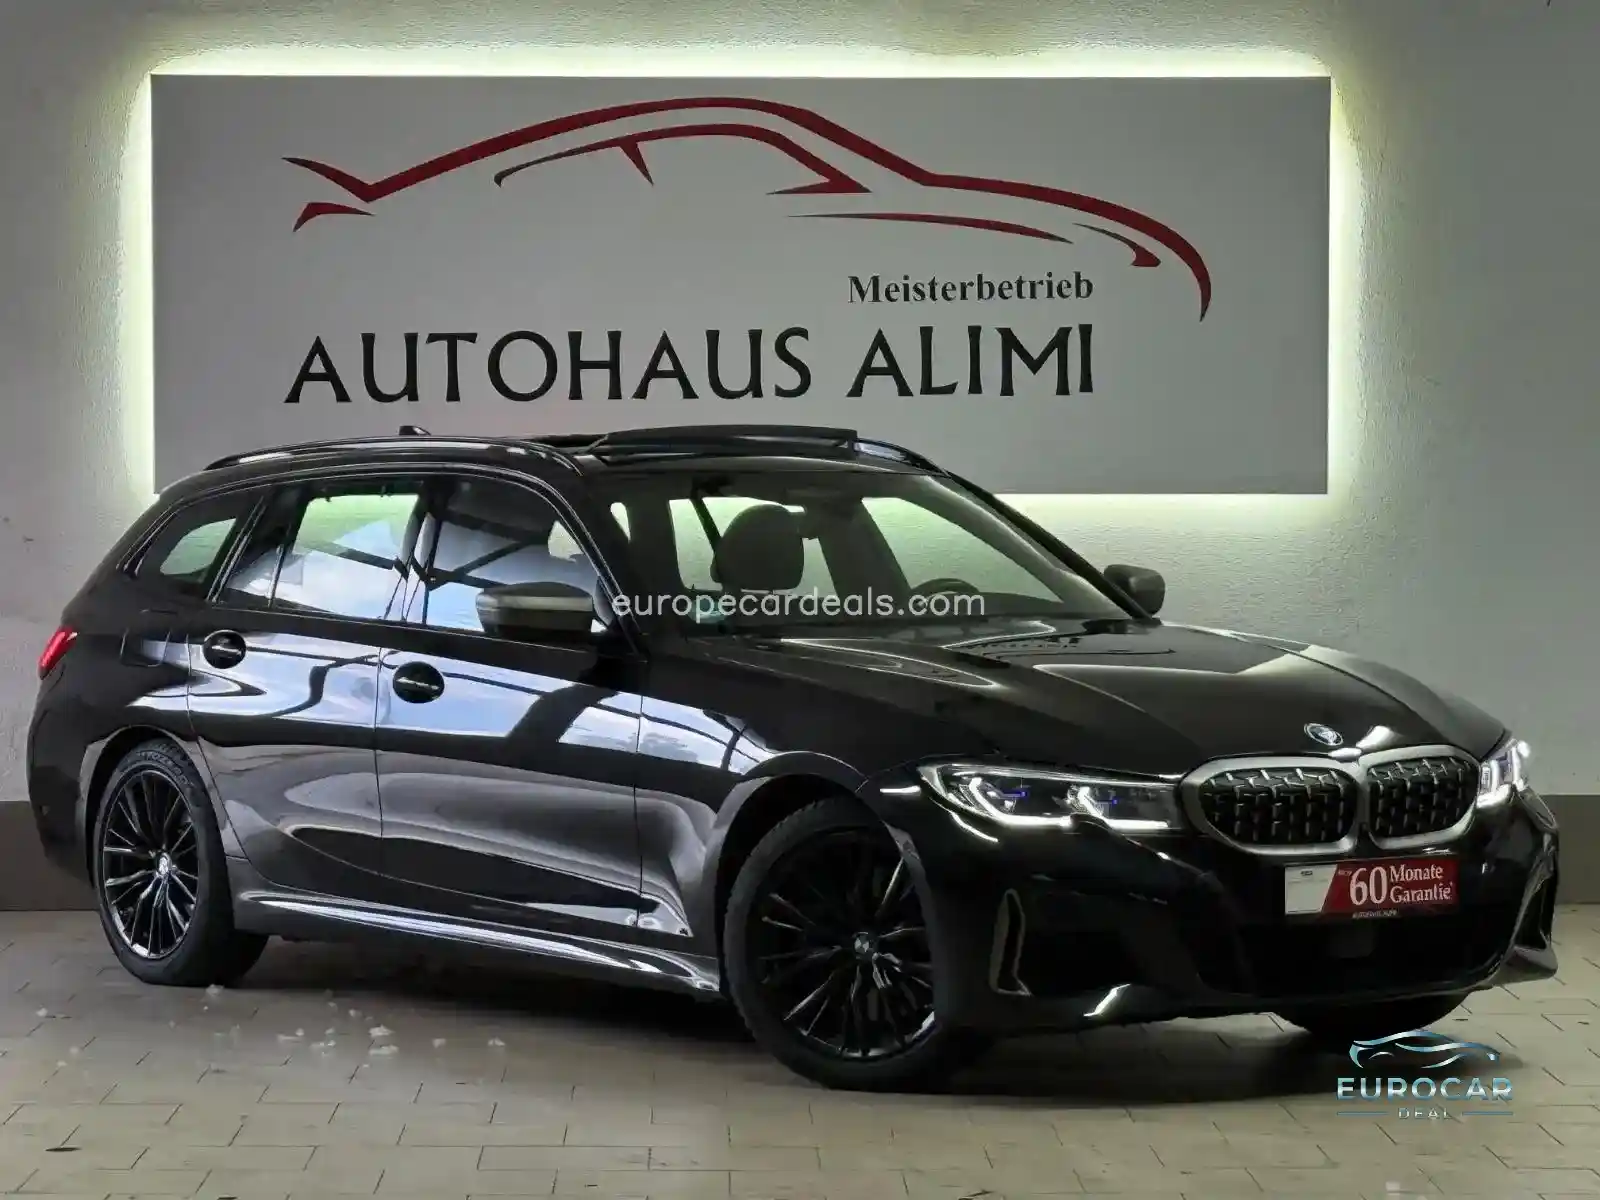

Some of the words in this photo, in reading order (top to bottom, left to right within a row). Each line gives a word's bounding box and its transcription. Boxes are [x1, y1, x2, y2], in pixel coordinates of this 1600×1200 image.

[848, 271, 1094, 303] Meisterbetrieb
[284, 326, 812, 404] AUTOHAUS
[846, 323, 1093, 398] ALIMI
[1349, 865, 1388, 906] 60
[1389, 864, 1444, 883] Monate
